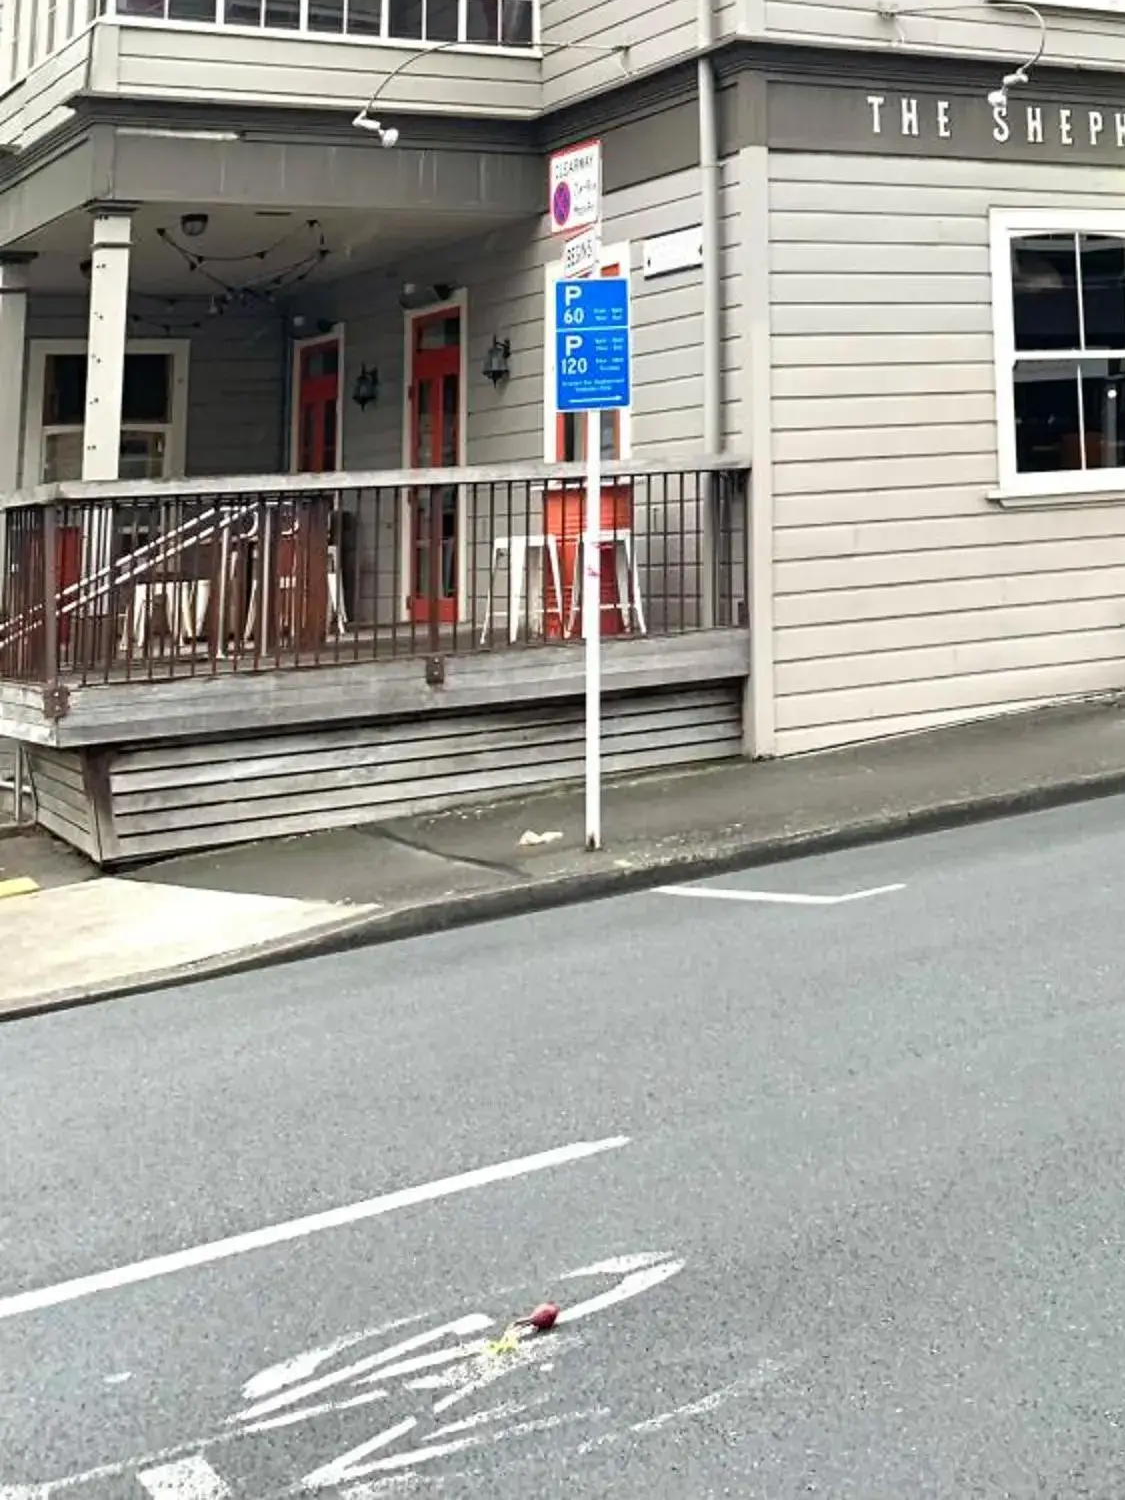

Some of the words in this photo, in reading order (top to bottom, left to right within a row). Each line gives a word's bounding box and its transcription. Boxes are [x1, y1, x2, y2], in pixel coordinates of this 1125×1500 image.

[867, 95, 951, 137] THE
[555, 154, 594, 180] CLEARWAY
[564, 285, 582, 306] P
[563, 307, 585, 324] 60
[565, 335, 583, 356] P
[561, 357, 588, 375] 120
